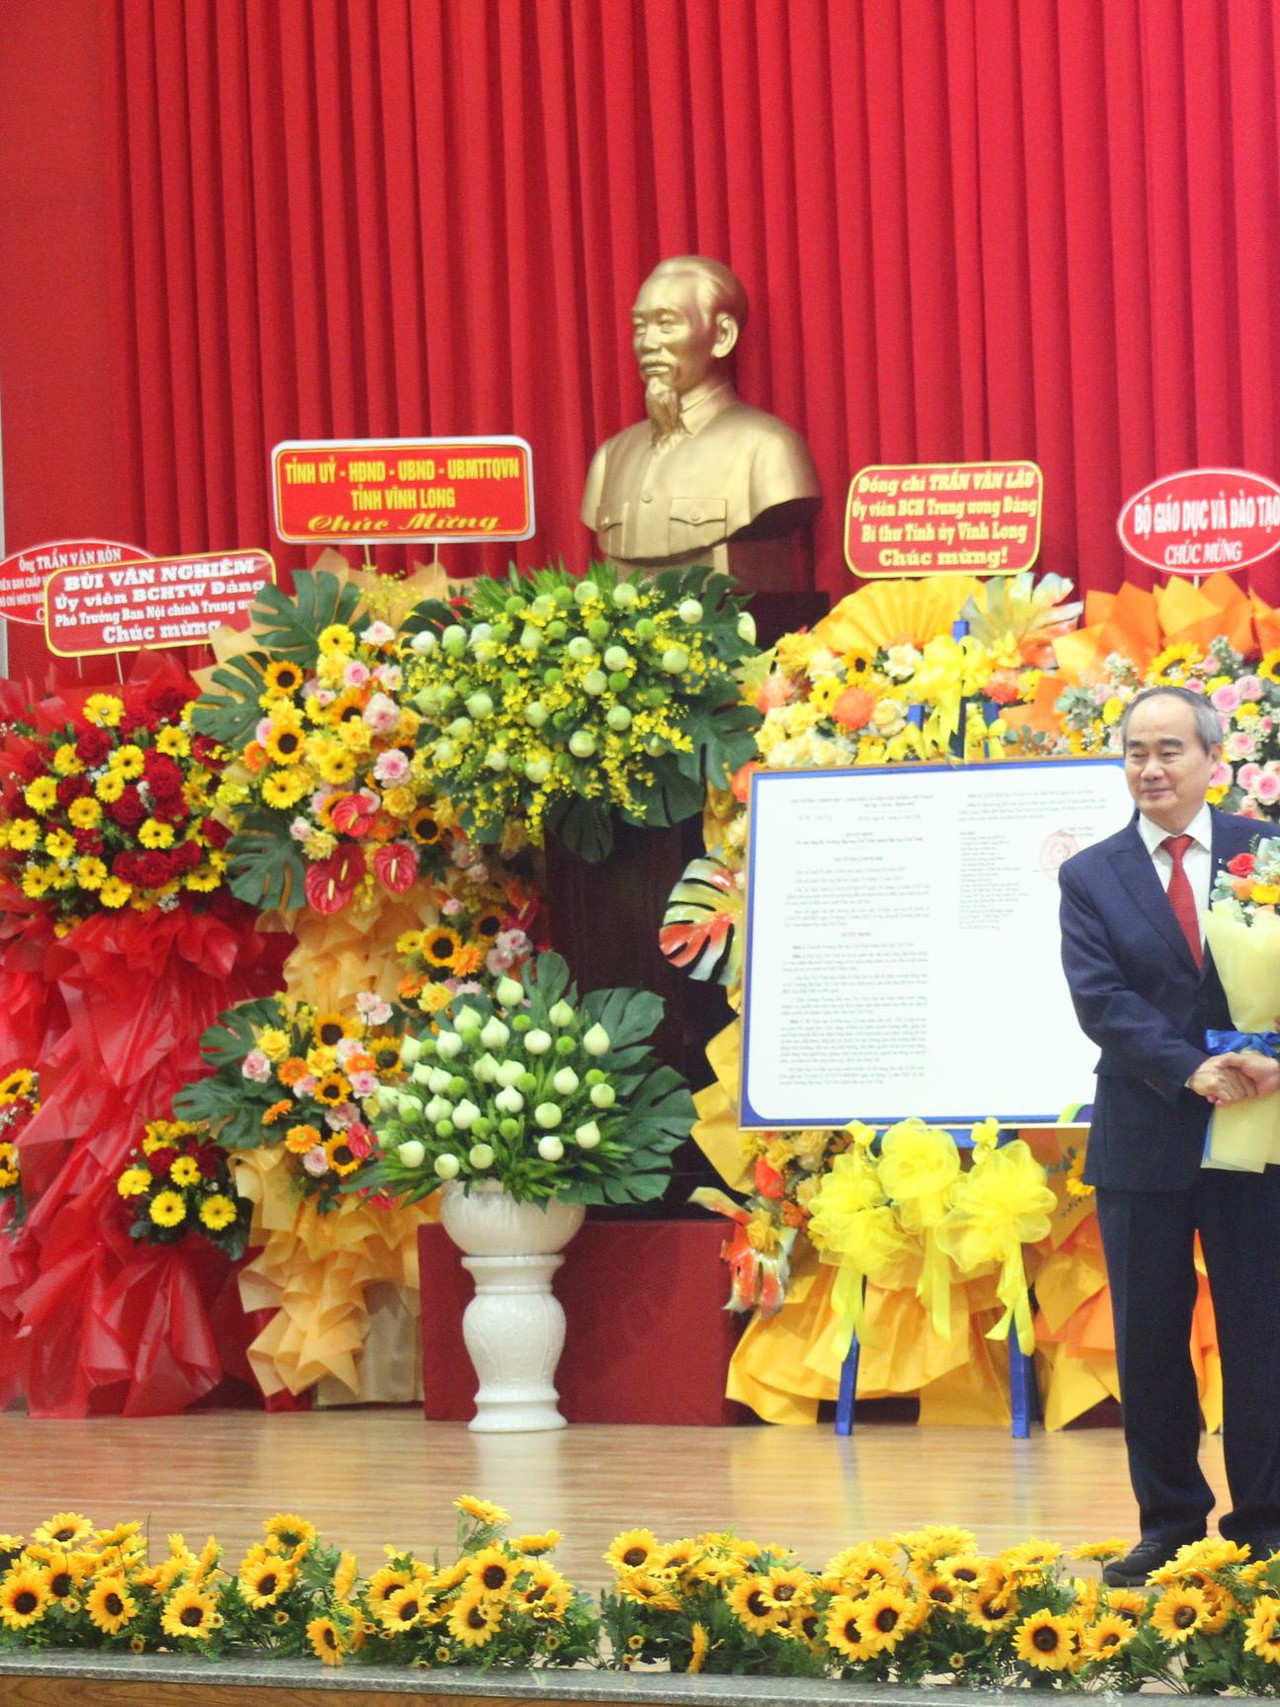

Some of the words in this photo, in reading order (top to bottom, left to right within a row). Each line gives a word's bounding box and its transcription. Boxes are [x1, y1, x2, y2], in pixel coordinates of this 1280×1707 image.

[285, 456, 316, 484] TỈNH
[319, 455, 336, 483] UỶ
[349, 460, 386, 482] HĐND
[398, 459, 435, 481] UBND
[447, 457, 520, 481] UBMTTQVN
[901, 475, 927, 493] chí
[973, 471, 1004, 490] VĂN
[351, 484, 382, 511] TỈNH
[385, 485, 417, 510] VĨNH
[420, 488, 455, 509] LONG
[869, 501, 896, 517] viên
[898, 498, 926, 517] BCH
[927, 499, 965, 519] Trung
[308, 514, 389, 533] Chúc
[398, 512, 499, 532] Mừng
[1134, 496, 1152, 541] BỘ
[1154, 493, 1181, 534] GIÁO
[1182, 499, 1209, 538] DỤC
[1210, 490, 1228, 530] VÀ
[1229, 489, 1256, 529] ĐÀO
[958, 521, 990, 541] Vĩnh
[992, 521, 1028, 544] Long
[70, 549, 95, 568] VĂN
[879, 548, 933, 567] Chúc
[937, 546, 1009, 569] mừng!
[1164, 539, 1202, 566] CHÚC
[1203, 537, 1243, 564] MỪNG
[64, 572, 104, 592] BÙI
[109, 568, 155, 587] VĂN
[160, 558, 256, 583] NGHIÊM
[54, 593, 79, 612] Ủy
[84, 591, 128, 607] viên
[132, 583, 206, 603] BCHTW
[54, 612, 78, 628] Phó
[122, 608, 144, 622] Ban
[146, 605, 166, 621] Nội
[167, 601, 199, 617] chính
[201, 599, 235, 615] Trung
[102, 624, 155, 644] Chúc
